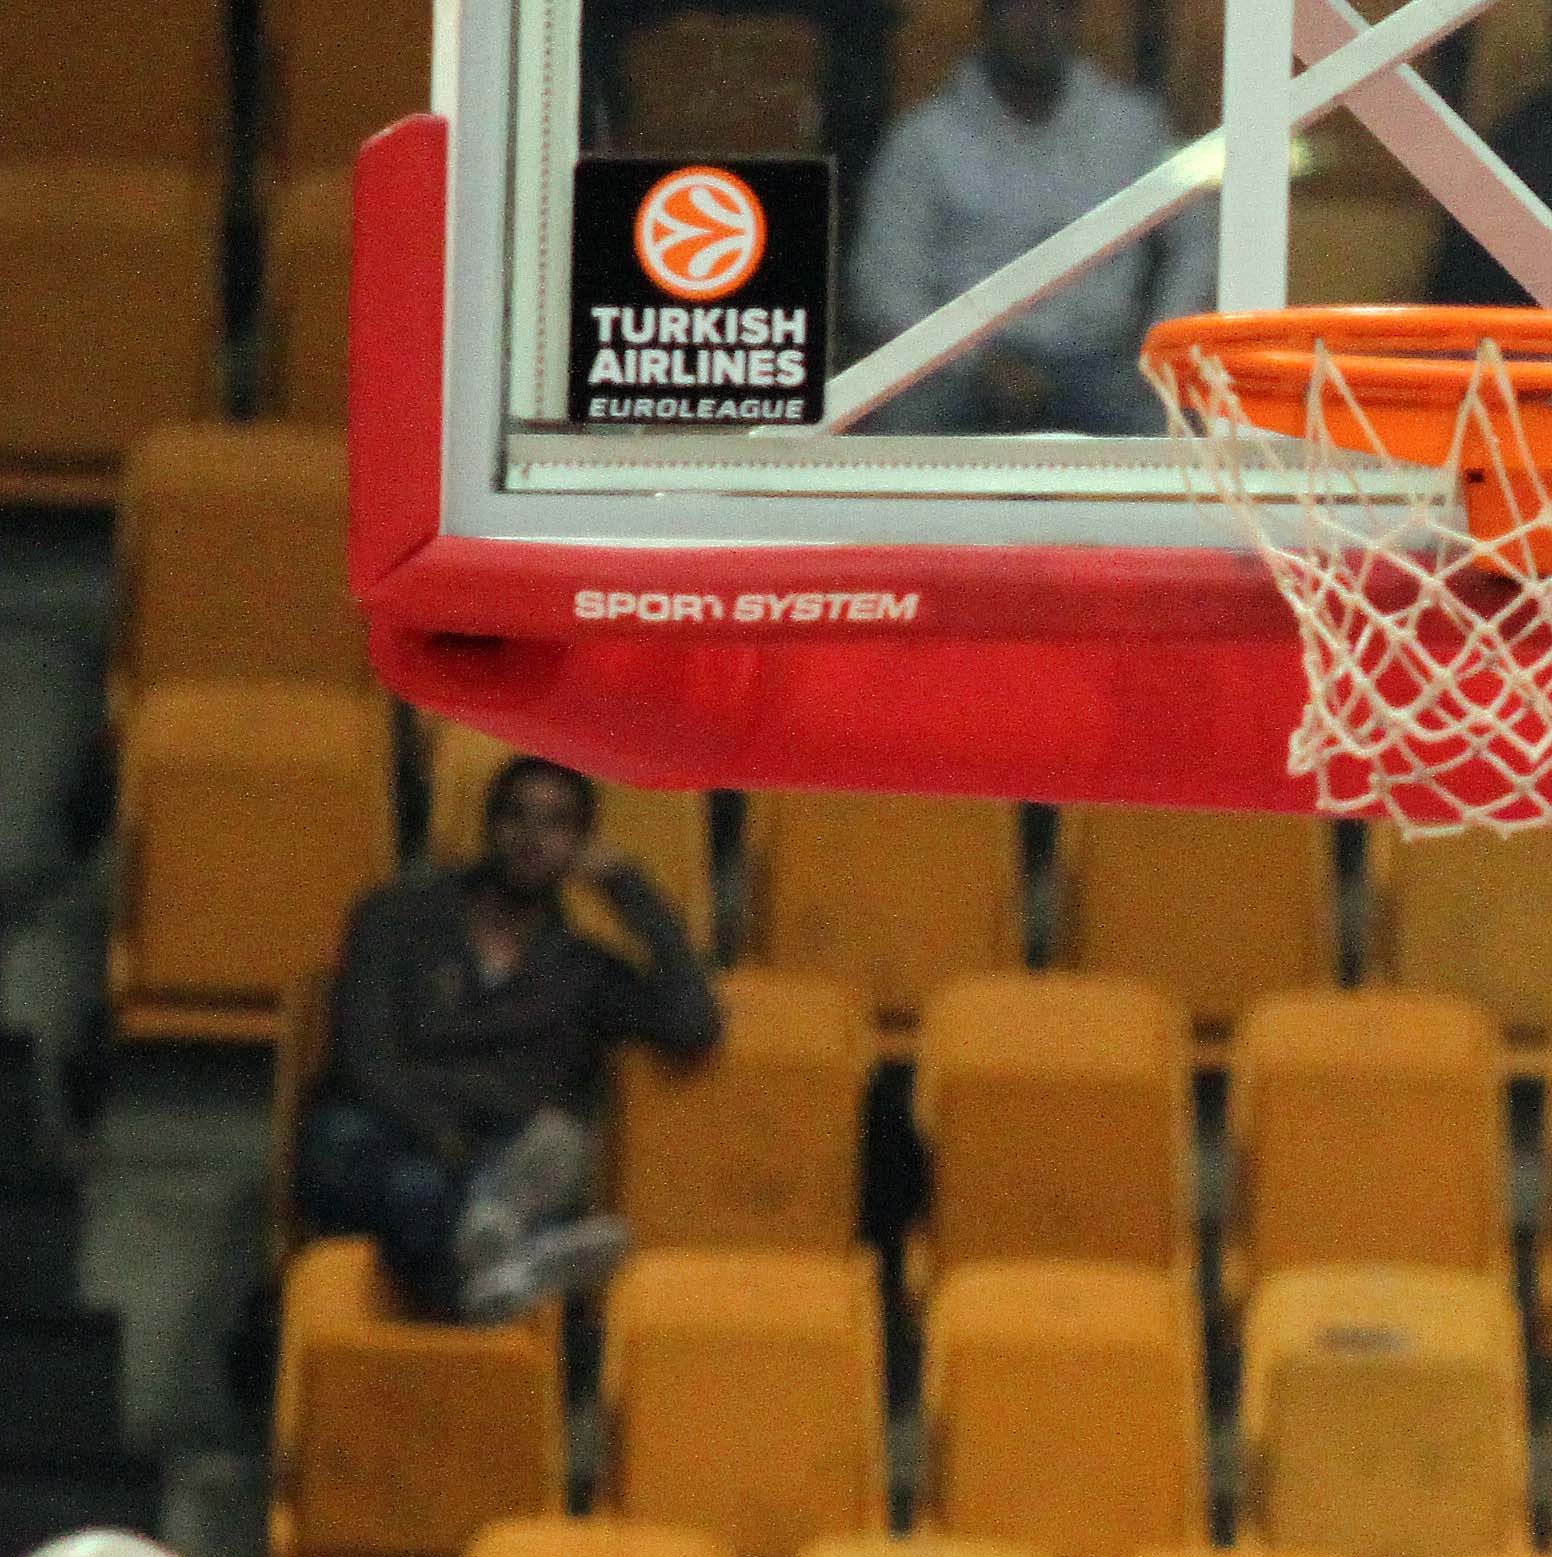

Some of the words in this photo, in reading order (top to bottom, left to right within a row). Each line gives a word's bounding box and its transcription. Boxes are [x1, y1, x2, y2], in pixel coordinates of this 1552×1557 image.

[590, 306, 807, 346] TURKISH
[587, 348, 807, 387] AIRLINES
[588, 397, 804, 420] EUROLEAGUE
[733, 591, 919, 622] SYSTEM
